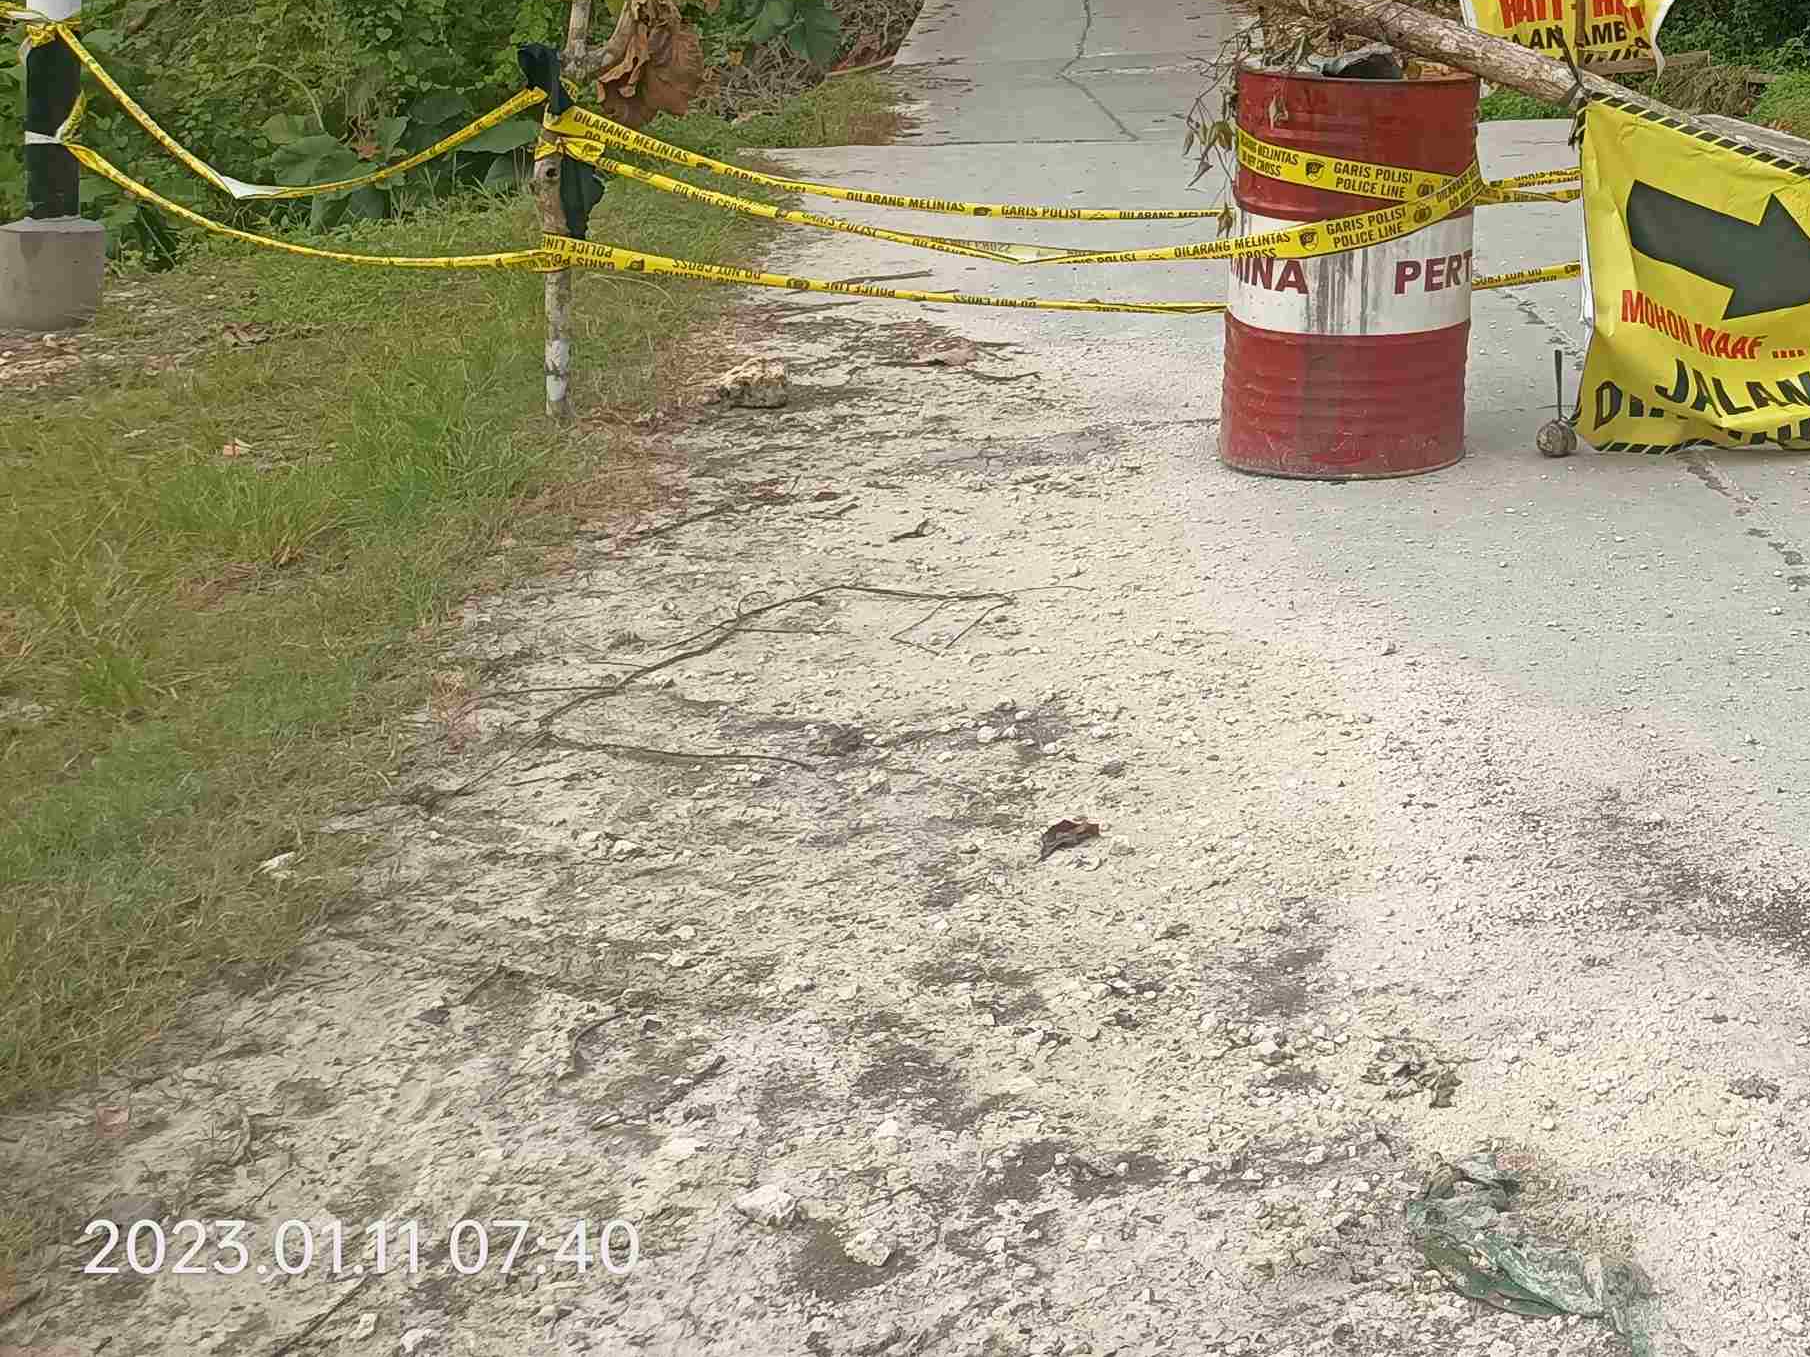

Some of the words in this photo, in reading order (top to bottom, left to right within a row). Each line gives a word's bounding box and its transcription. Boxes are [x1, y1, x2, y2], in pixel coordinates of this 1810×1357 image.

[574, 111, 631, 141] DILARANG
[633, 133, 691, 164] MELINTAS
[1333, 161, 1371, 181] GARIS
[1375, 167, 1413, 185] POLISI
[1335, 178, 1379, 197] POLICE
[1380, 183, 1408, 200] LINE
[846, 191, 905, 208] DILARANG
[908, 199, 966, 213] MELINTAS
[1001, 205, 1038, 218] GARIS
[1326, 216, 1364, 236] GARIS
[1367, 208, 1407, 227] POLISI
[1332, 230, 1376, 248] POLICE
[1378, 222, 1403, 240] LINE
[1173, 240, 1231, 259] DILARANG
[1234, 232, 1291, 250] MELINTAS
[1621, 289, 1693, 347] MOHON
[1694, 322, 1769, 360] MAAF
